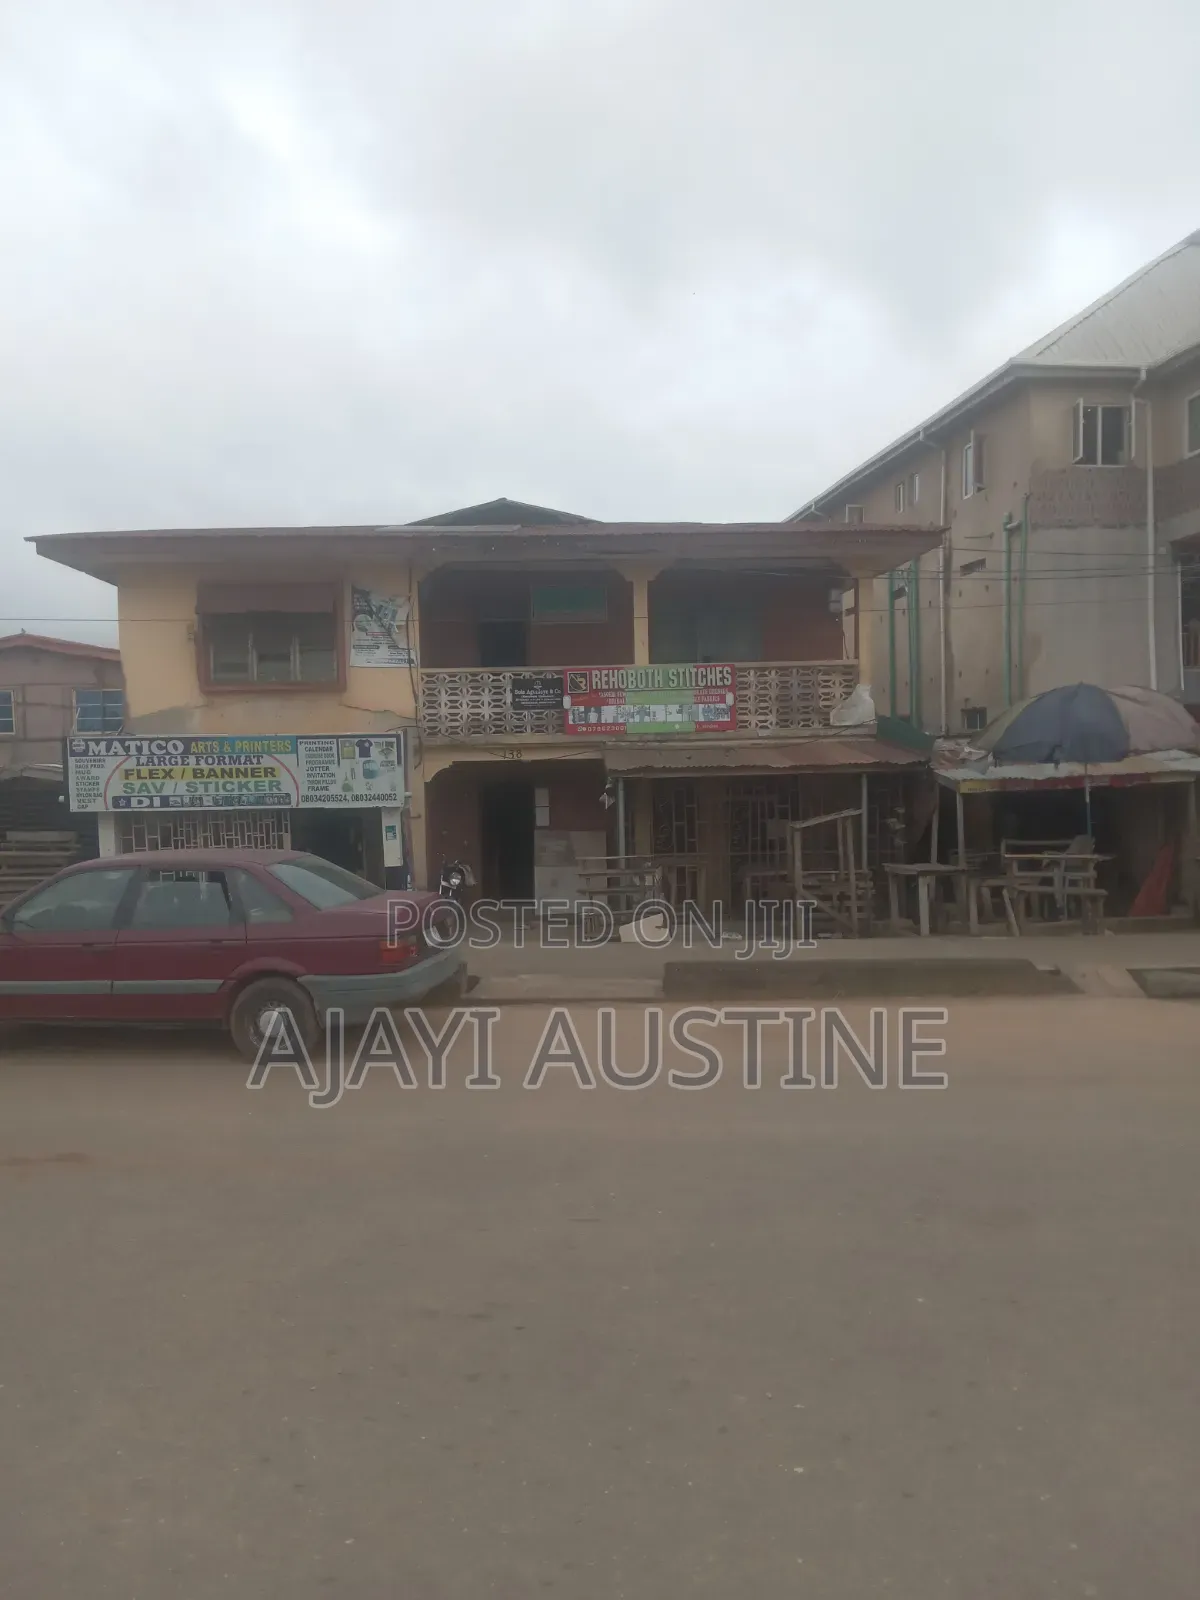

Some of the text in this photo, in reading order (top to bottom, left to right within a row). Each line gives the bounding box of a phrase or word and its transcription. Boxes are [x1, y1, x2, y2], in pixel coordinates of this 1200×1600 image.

[592, 666, 732, 690] REHOBOTH STITCHES
[87, 740, 292, 756] MATICO ARTS & PRINTERS
[135, 755, 264, 767] LARGE FORMAT
[124, 766, 277, 781] FLEX / BANNER
[122, 782, 166, 795] SAV
[185, 780, 282, 794] STICKER
[351, 792, 398, 802] 08032440052
